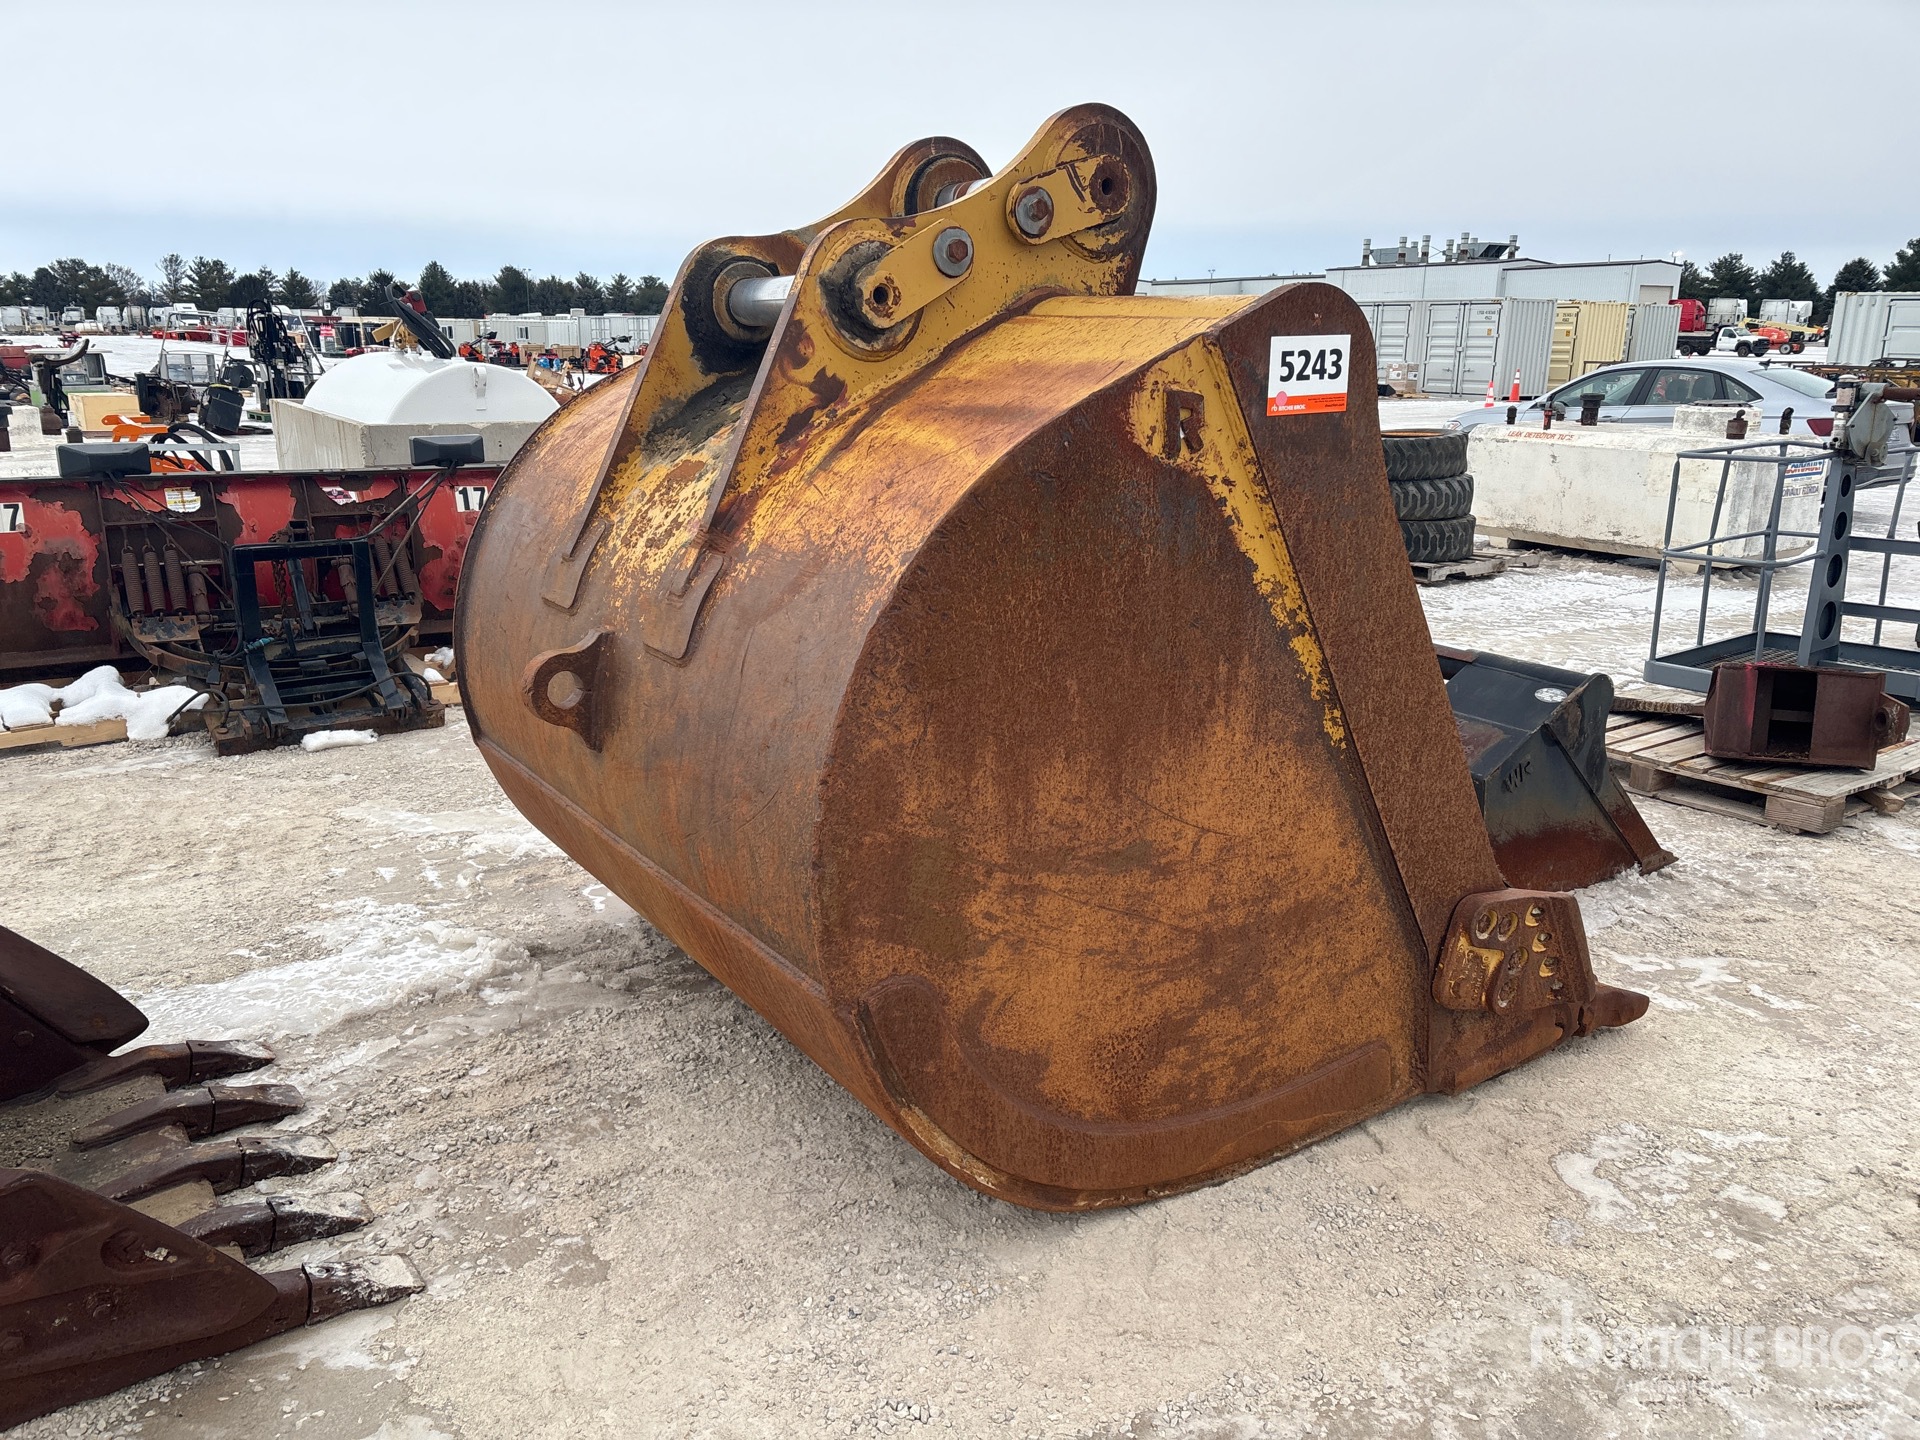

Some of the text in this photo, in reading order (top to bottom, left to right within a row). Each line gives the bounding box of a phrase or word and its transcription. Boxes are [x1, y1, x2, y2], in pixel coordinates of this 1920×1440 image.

[1279, 348, 1343, 382] 5243
[1163, 387, 1205, 460] R
[1507, 430, 1523, 438] LEAK
[1524, 431, 1557, 440] DETECTOR
[458, 486, 486, 511] 17
